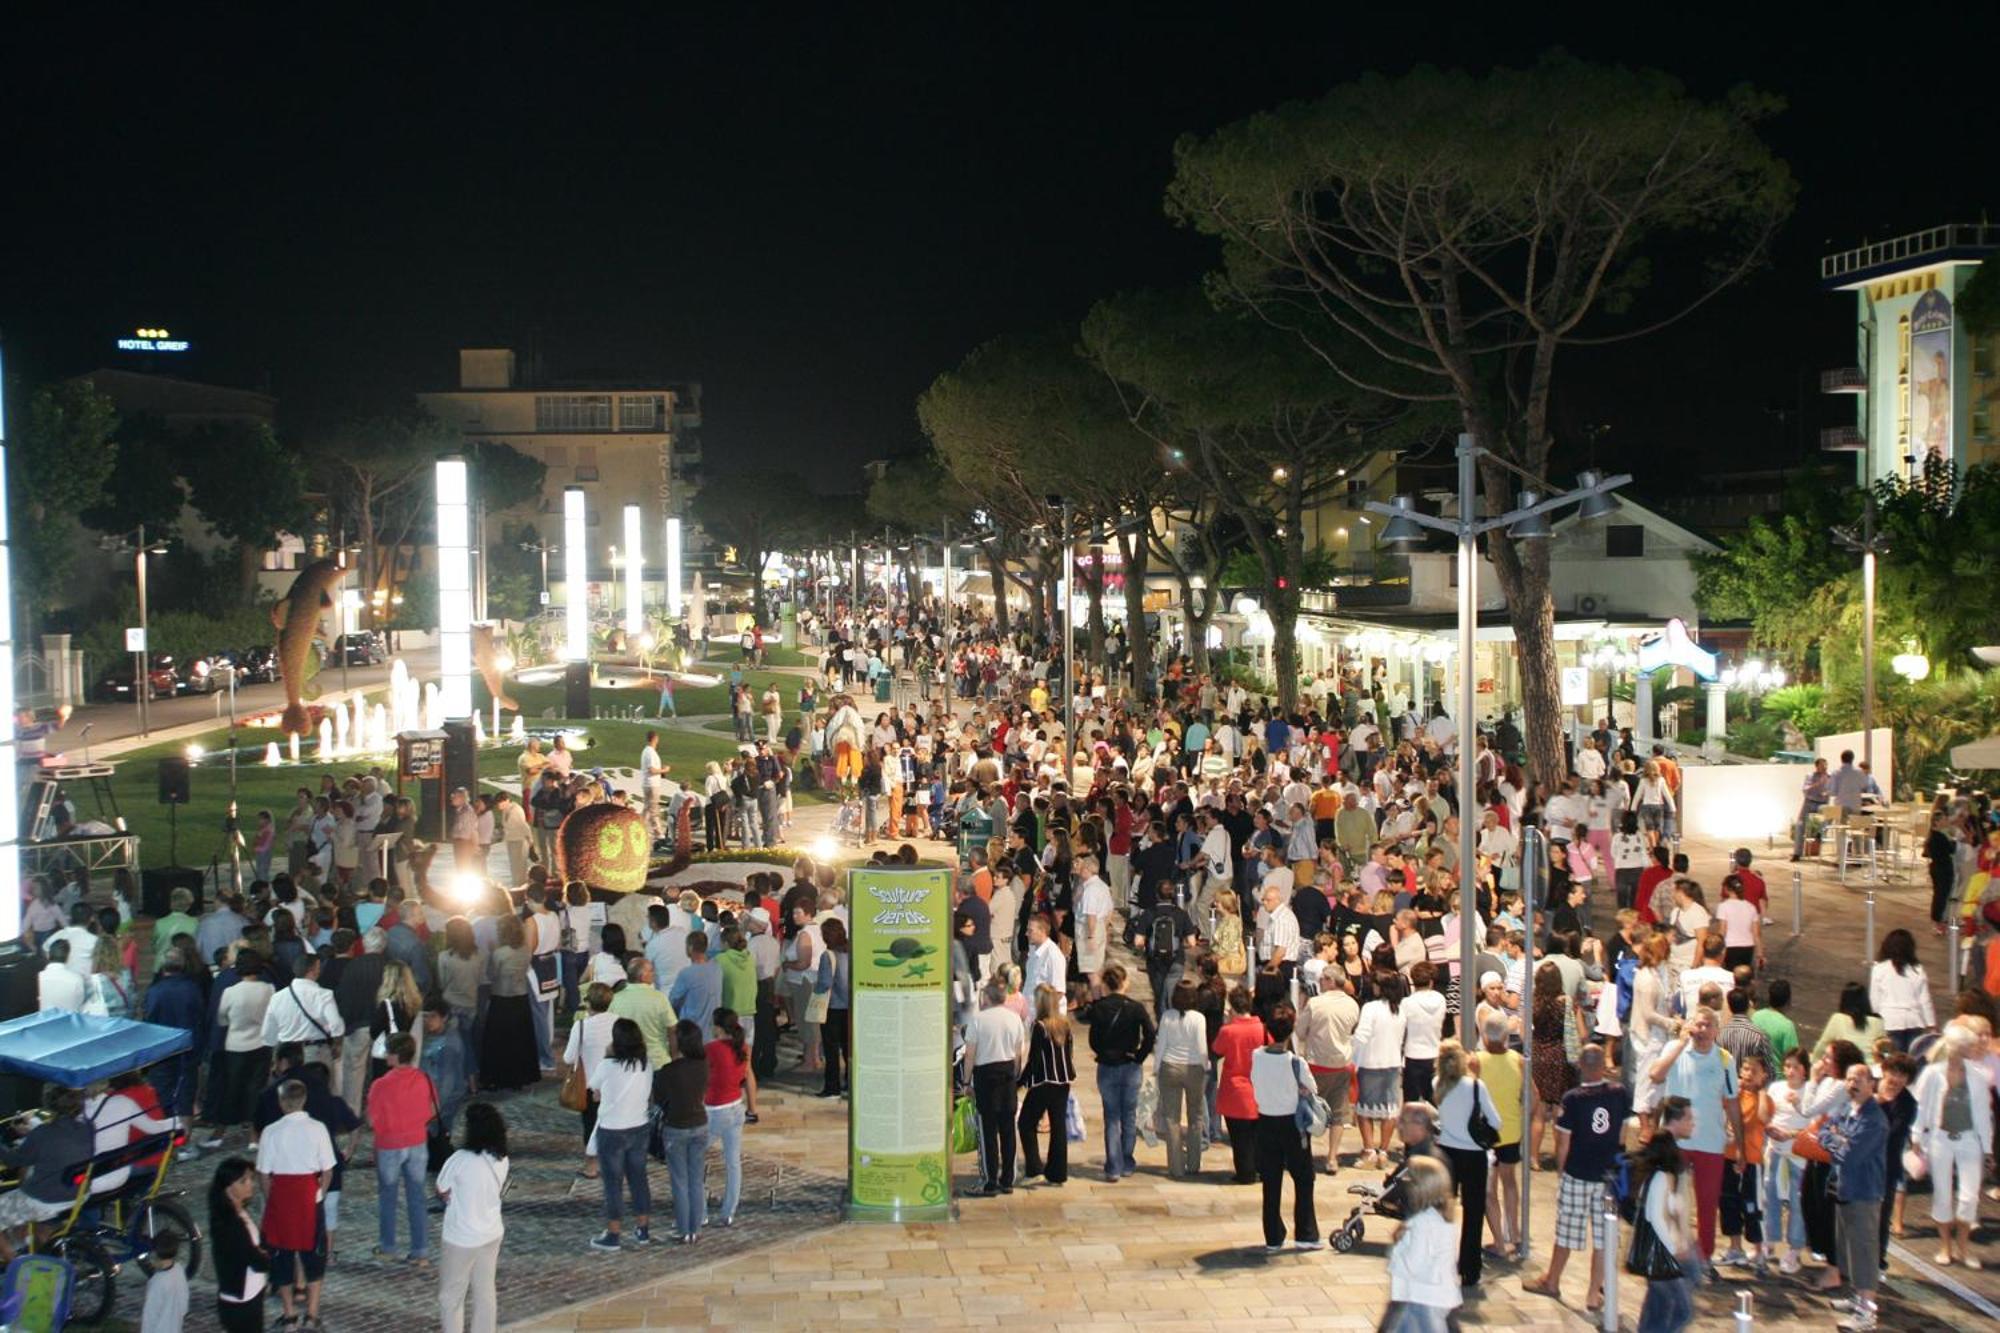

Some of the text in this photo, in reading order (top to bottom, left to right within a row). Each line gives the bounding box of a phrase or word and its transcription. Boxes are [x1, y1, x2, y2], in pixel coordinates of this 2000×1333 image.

[118, 339, 188, 351] HOTEL GREIF
[869, 886, 930, 904] Sculture
[1592, 1107, 1609, 1134] 8
